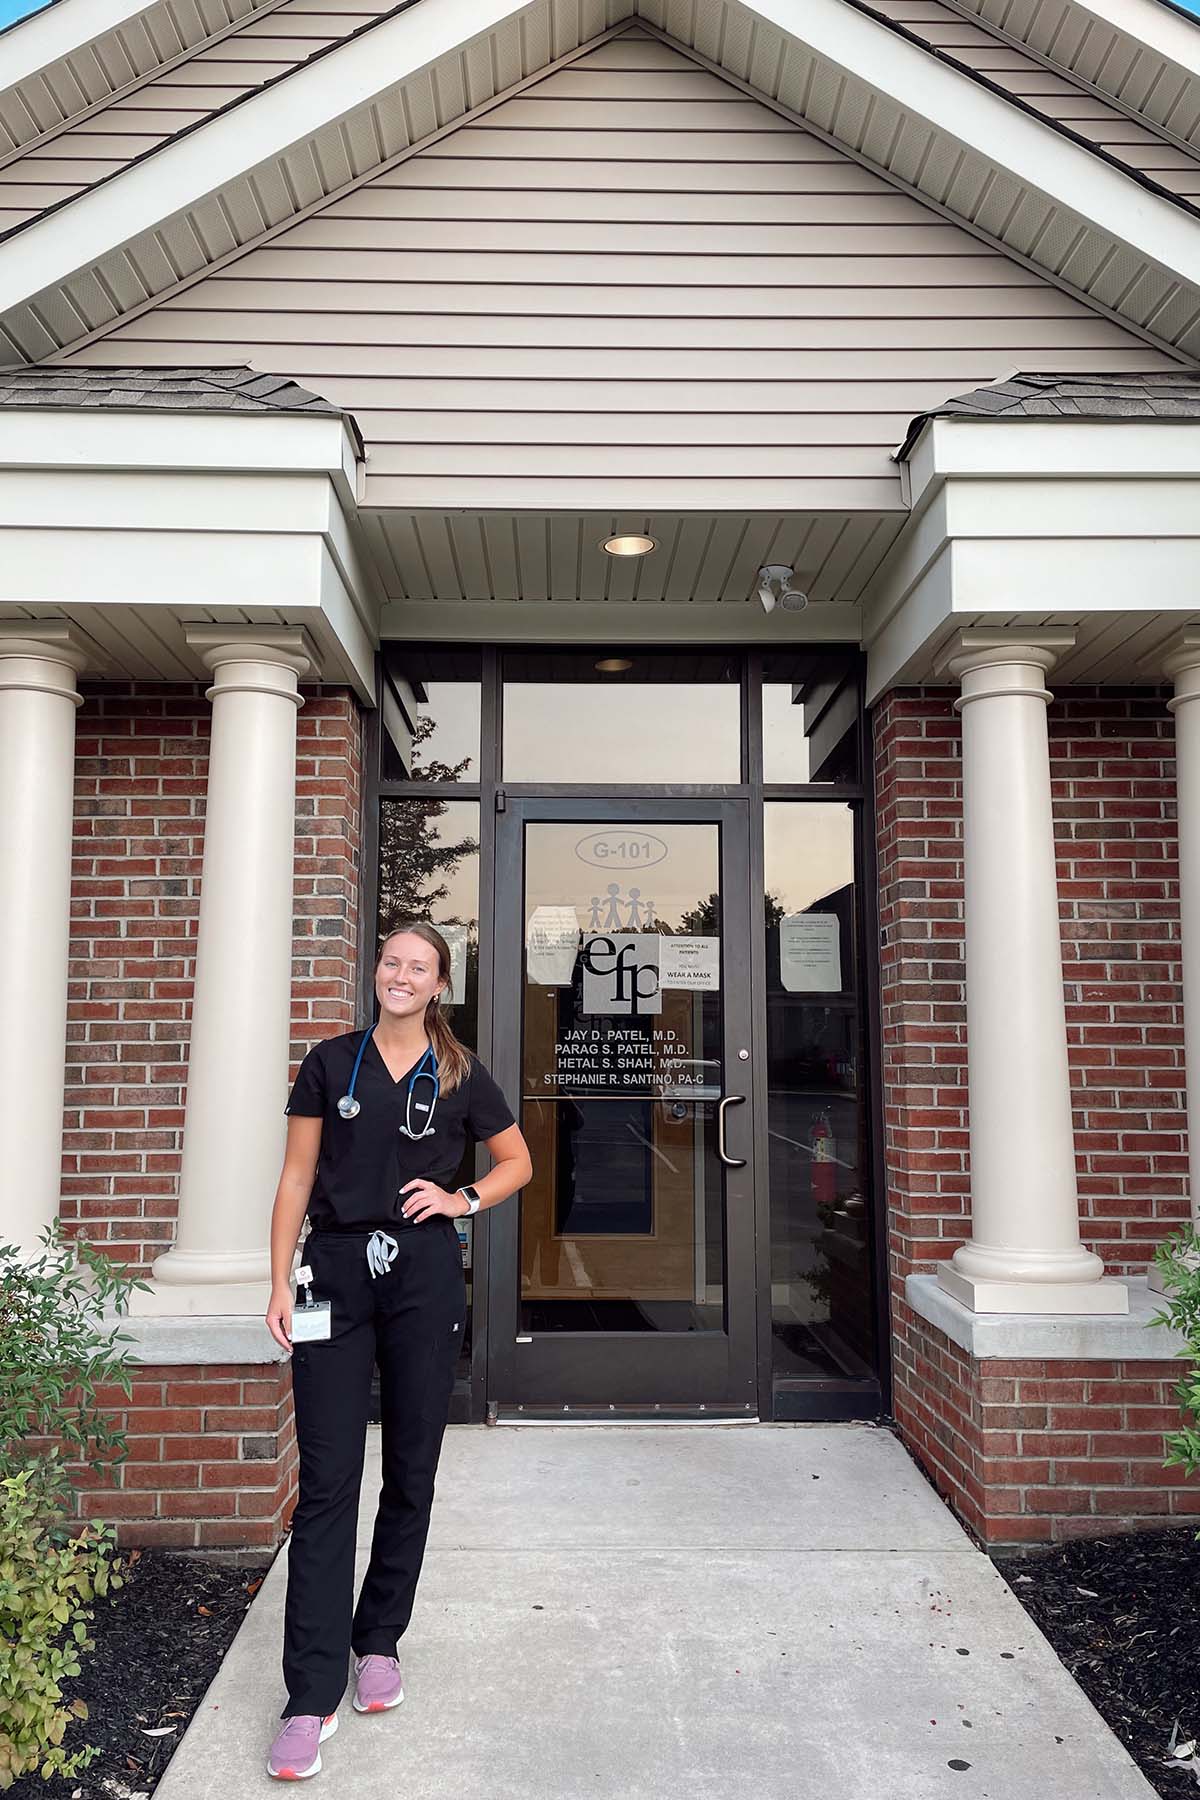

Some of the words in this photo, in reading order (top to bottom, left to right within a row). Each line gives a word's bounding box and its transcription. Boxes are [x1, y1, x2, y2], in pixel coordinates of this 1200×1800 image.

[593, 842, 652, 858] G-101
[583, 937, 659, 1014] efp
[564, 1030, 590, 1040] JAY
[592, 1030, 604, 1040] D.
[607, 1030, 650, 1042] PATEL,
[653, 1030, 678, 1040] M.D.
[554, 1044, 598, 1054] PARAG
[602, 1044, 614, 1054] S.
[617, 1044, 660, 1056] PATEL,
[664, 1044, 689, 1054] M.D.
[558, 1058, 598, 1068] HETAL
[602, 1058, 614, 1068] S.
[618, 1058, 656, 1070] SHAH,
[660, 1058, 686, 1068] M.D.
[544, 1074, 606, 1084] STEPHANIE
[609, 1074, 620, 1084] R.
[623, 1074, 674, 1086] SANTINO,
[678, 1074, 704, 1084] PA-C
